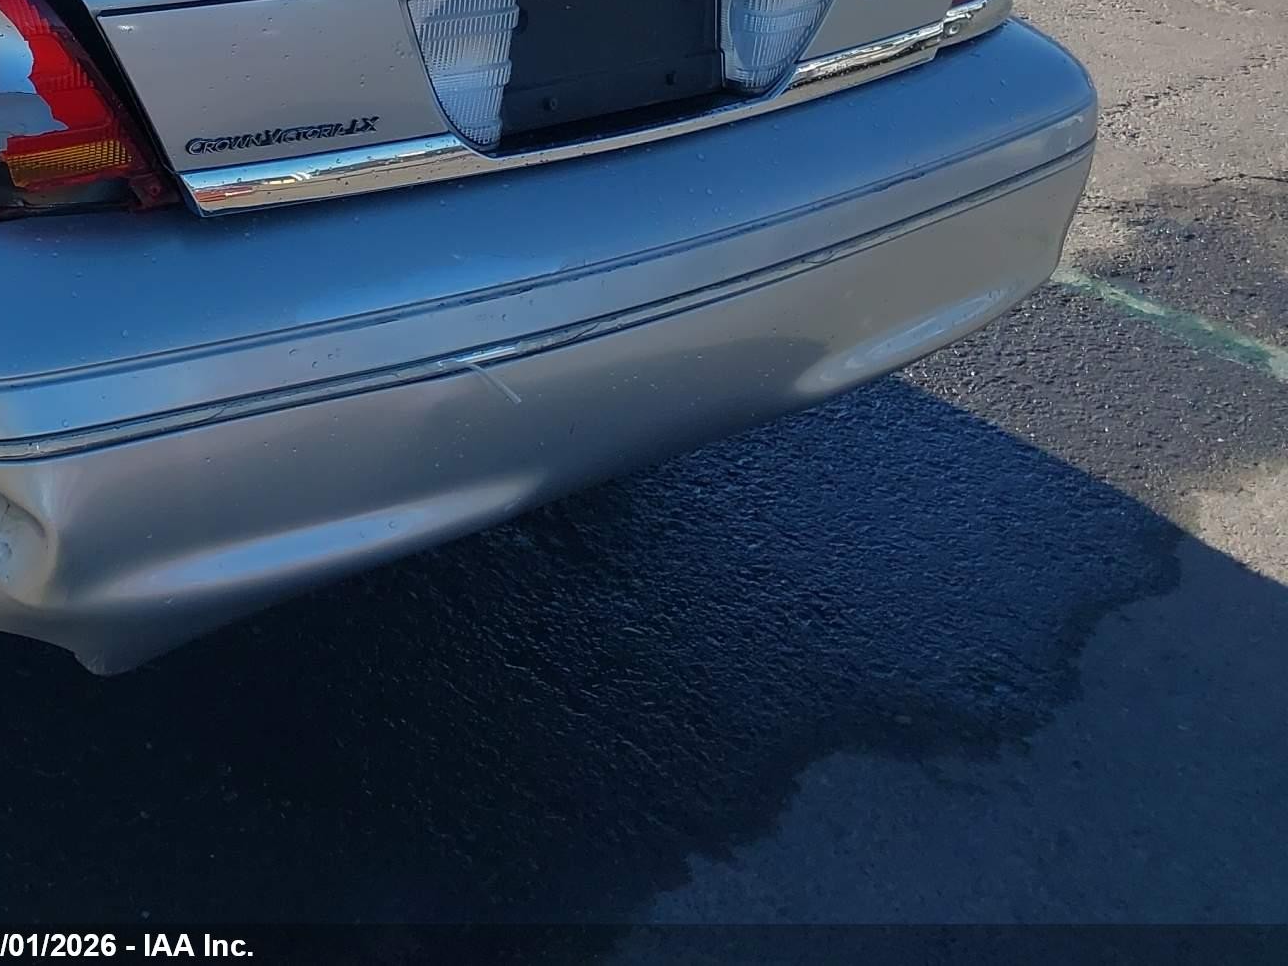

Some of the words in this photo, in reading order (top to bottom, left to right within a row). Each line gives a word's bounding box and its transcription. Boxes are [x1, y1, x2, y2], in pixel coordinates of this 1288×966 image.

[185, 131, 263, 155] CROWN
[262, 122, 345, 146] VICTORIA
[344, 115, 380, 135] LX
